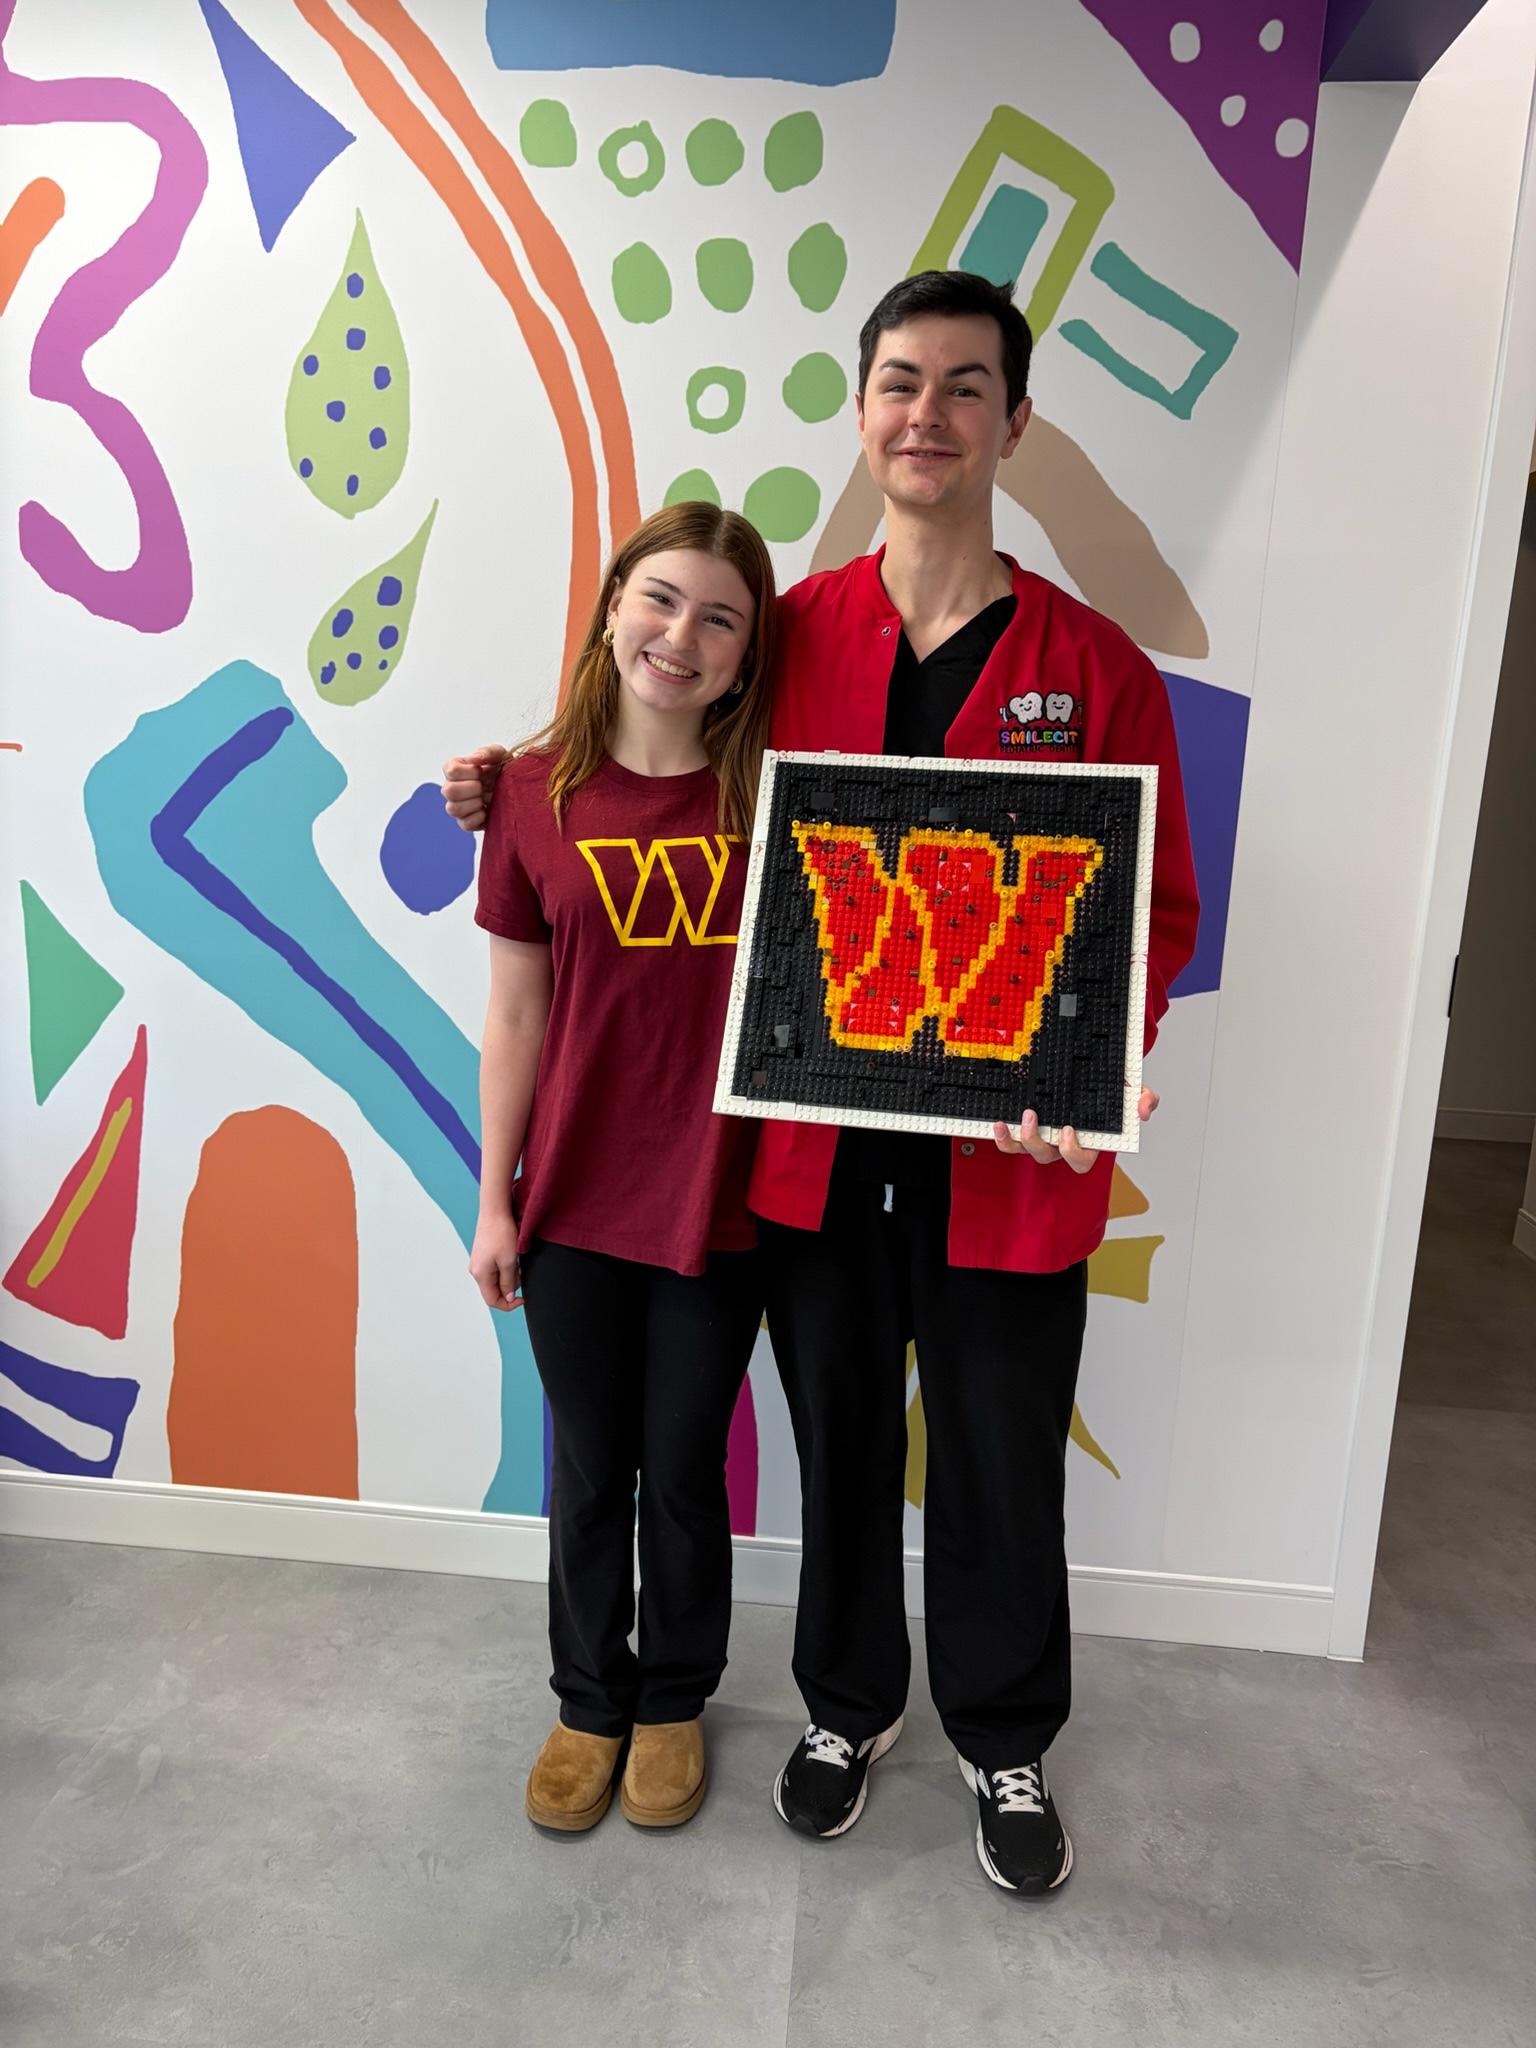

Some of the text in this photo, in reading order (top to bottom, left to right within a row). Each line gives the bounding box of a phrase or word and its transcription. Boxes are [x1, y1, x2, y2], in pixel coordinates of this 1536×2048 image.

[1000, 730, 1079, 745] SMILECIT
[575, 834, 744, 947] W
[792, 819, 1104, 1062] W
